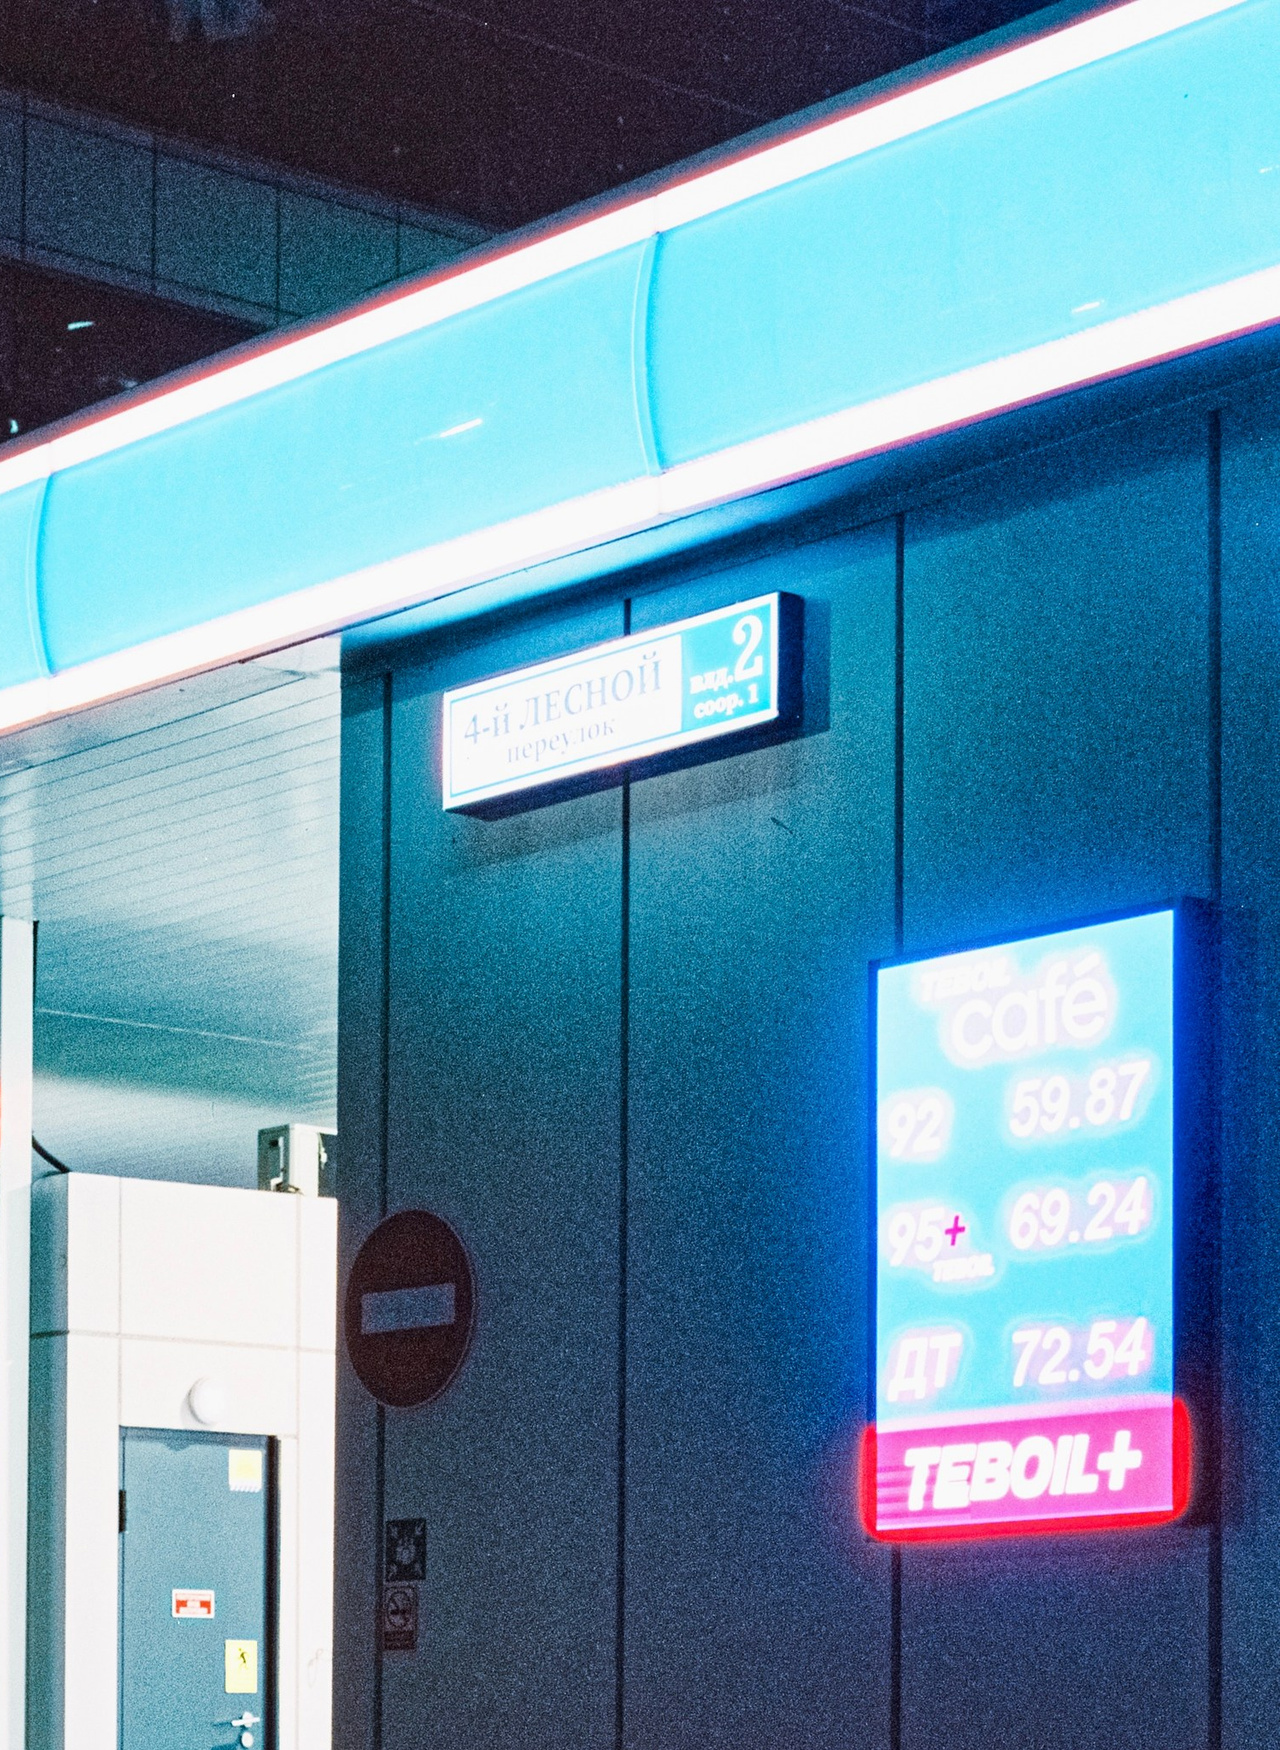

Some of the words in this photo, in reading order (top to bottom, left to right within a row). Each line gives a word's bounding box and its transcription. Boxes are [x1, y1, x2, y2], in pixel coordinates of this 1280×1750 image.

[732, 613, 764, 682] 2
[464, 705, 511, 745] 4-й
[519, 651, 663, 731] ЛЕСНОЙ
[747, 682, 759, 704] 1
[507, 718, 616, 765] переулок
[951, 952, 1109, 1059] café
[887, 1099, 945, 1158] 92
[1009, 1059, 1152, 1138] 59.87
[1009, 1175, 1148, 1250] 69.24
[886, 1331, 963, 1402] ДТ
[1012, 1316, 1148, 1388] 72.54
[904, 1429, 1143, 1512] TEBOIL+
